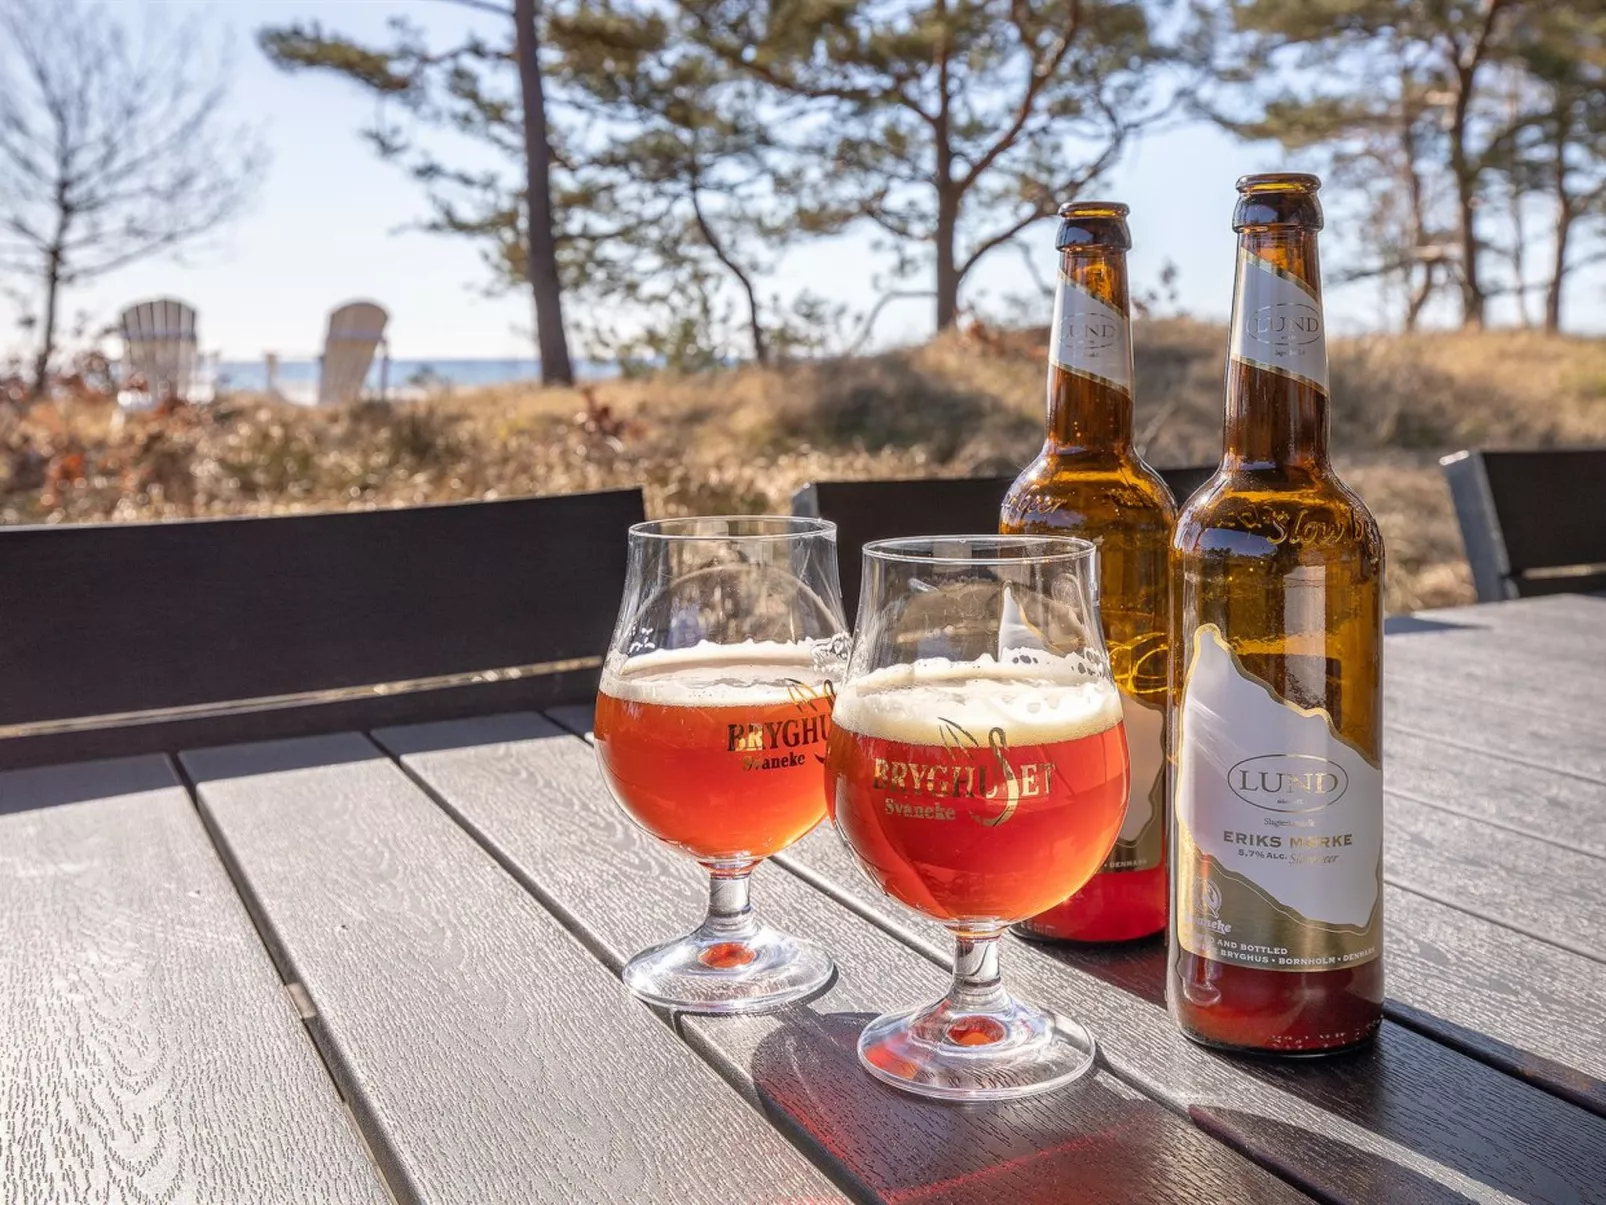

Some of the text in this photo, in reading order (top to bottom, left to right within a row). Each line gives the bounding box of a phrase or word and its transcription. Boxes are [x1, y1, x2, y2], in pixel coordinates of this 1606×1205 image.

[1253, 316, 1319, 333] LUND
[1239, 769, 1338, 794] LUND
[884, 798, 957, 821] Svaneke
[1223, 830, 1282, 848] ERIKS
[1217, 939, 1238, 950] AND
[1240, 943, 1288, 956] BOTTLED
[1219, 949, 1269, 964] BRYGHUS
[1278, 957, 1336, 966] BORNHOLM
